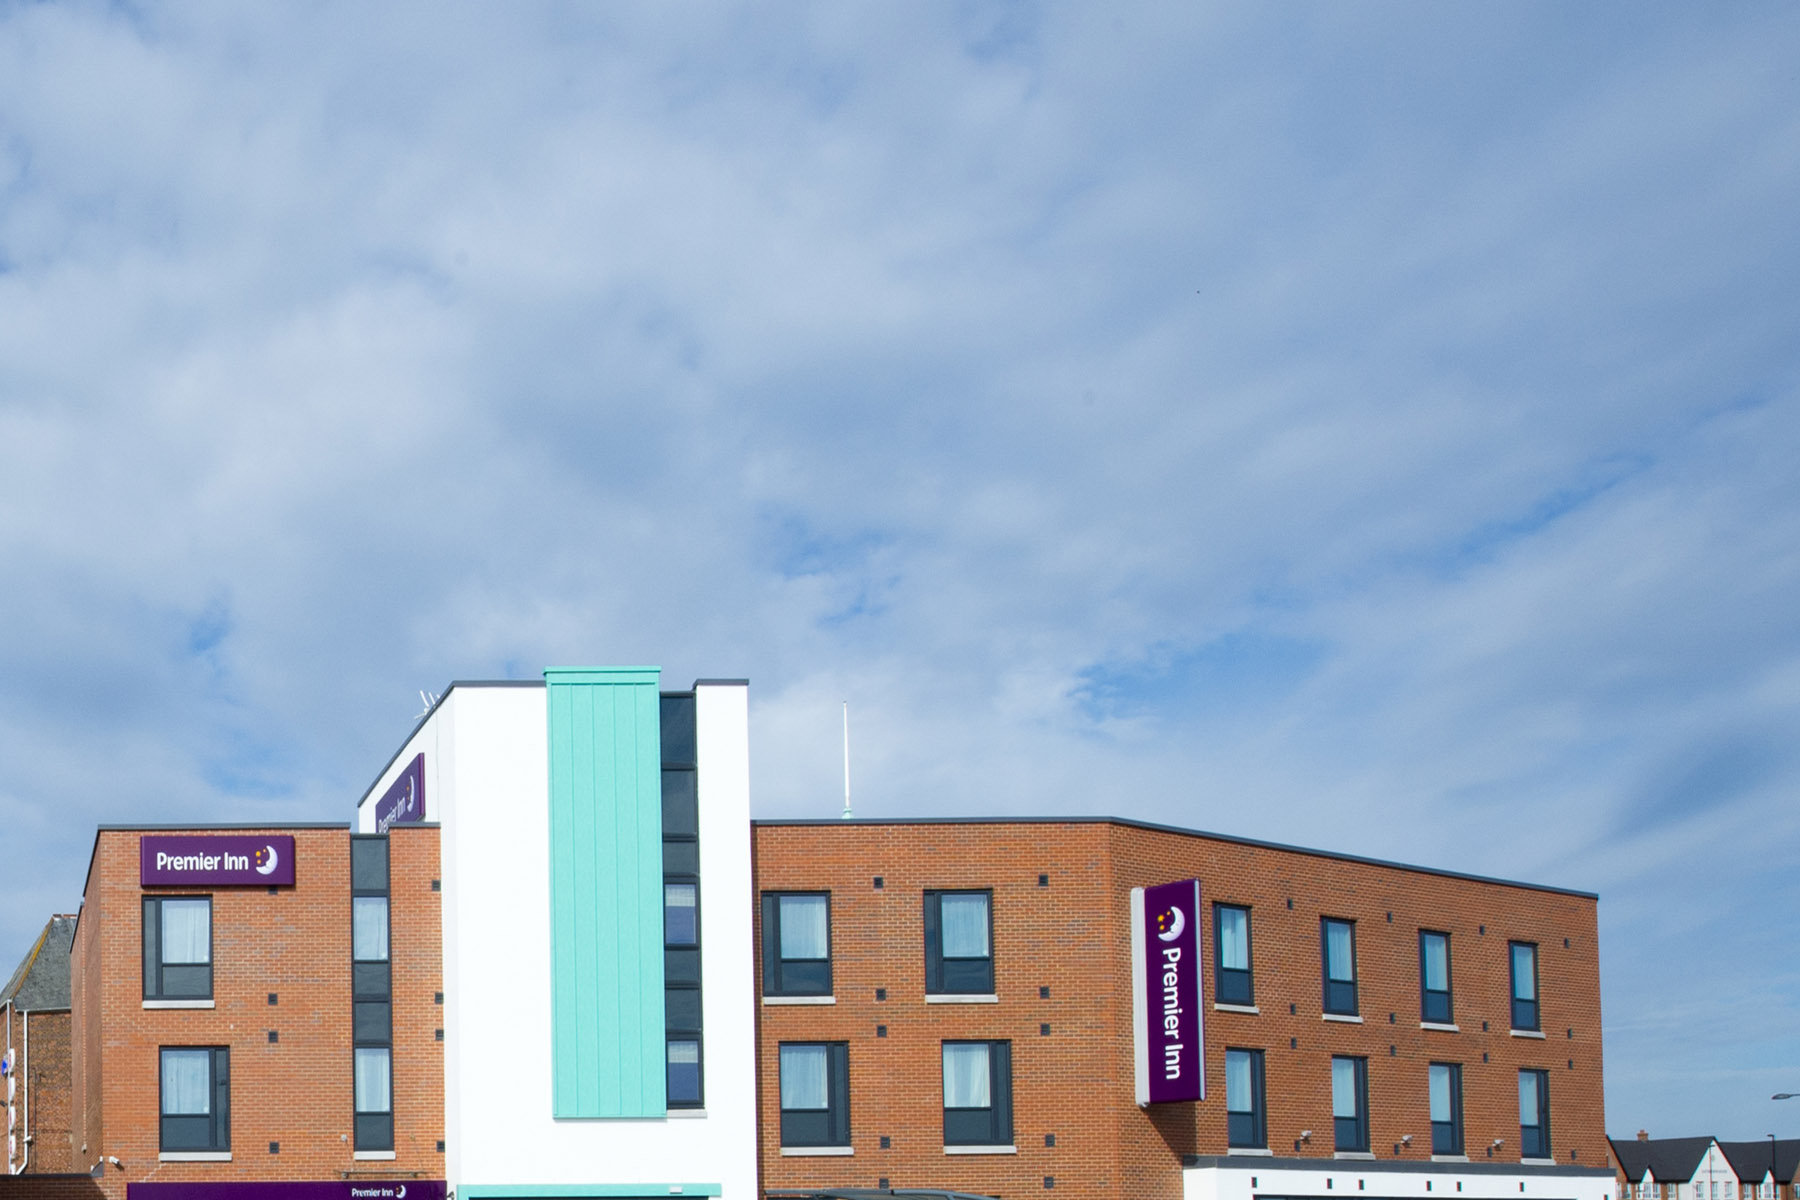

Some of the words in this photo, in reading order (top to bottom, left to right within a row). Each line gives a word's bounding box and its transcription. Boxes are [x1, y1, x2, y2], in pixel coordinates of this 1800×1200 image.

[397, 797, 406, 819] Inn
[156, 851, 222, 871] Premier
[223, 851, 249, 871] Inn
[1162, 947, 1183, 1040] Premier
[1165, 1043, 1184, 1081] Inn
[351, 1187, 381, 1197] Premier
[381, 1187, 394, 1197] Inn
